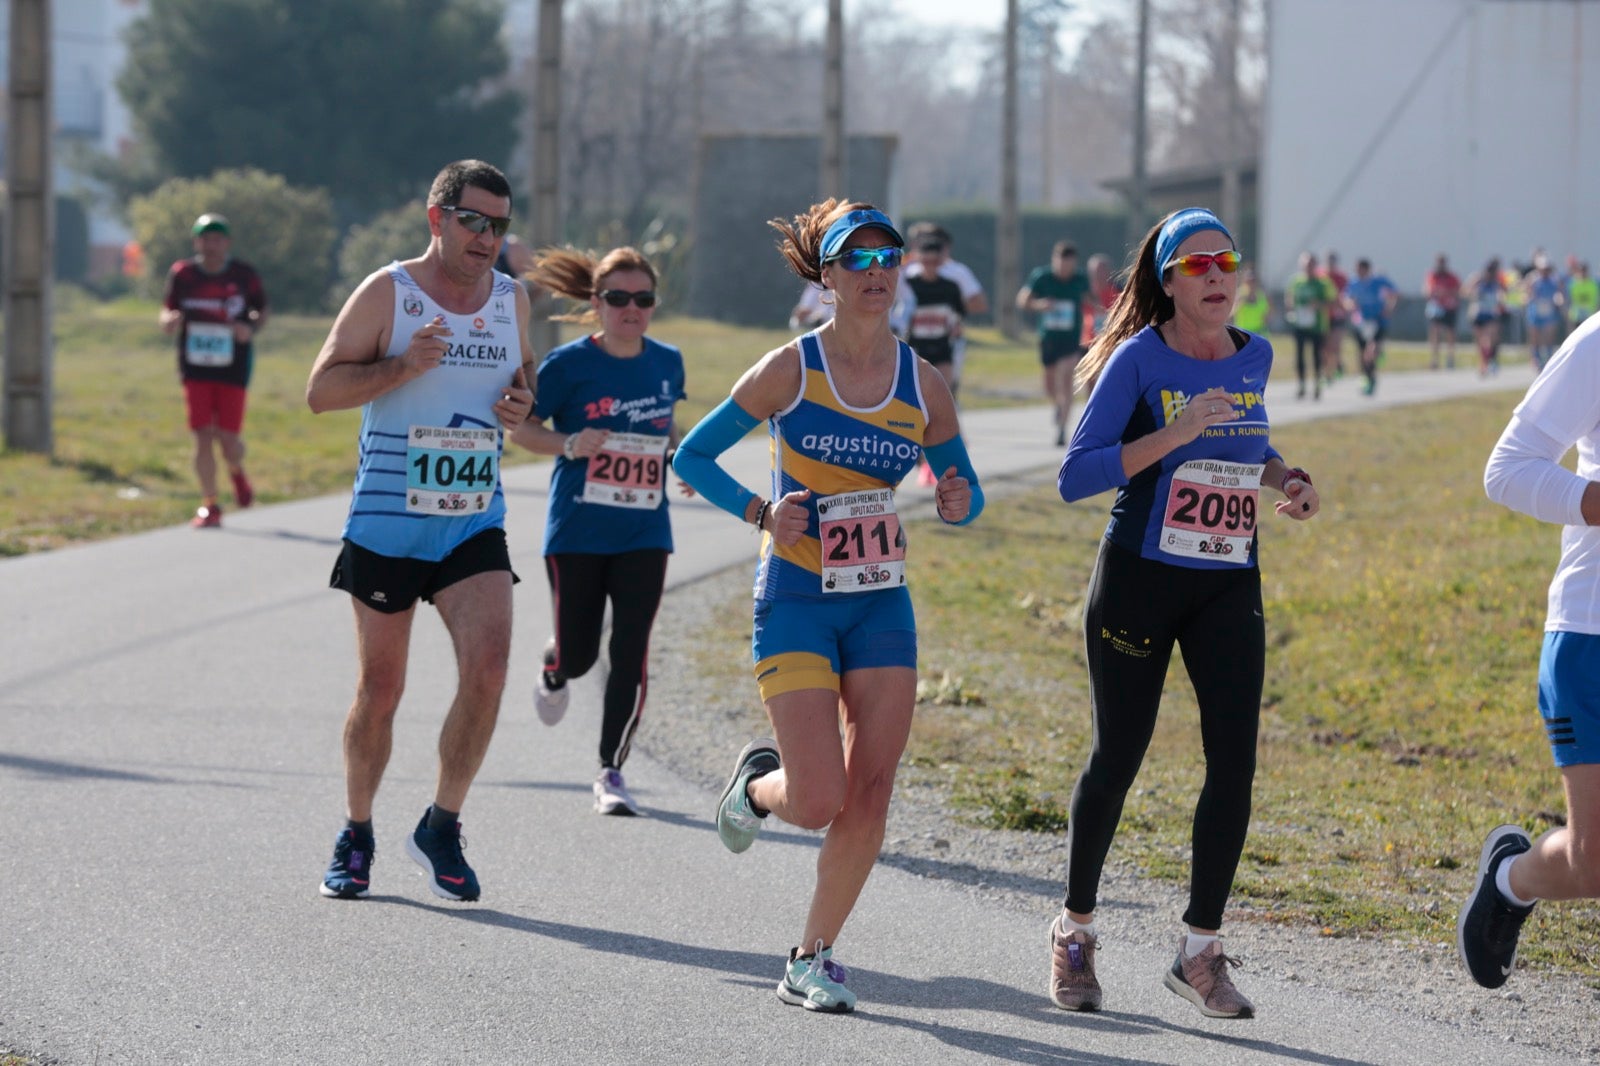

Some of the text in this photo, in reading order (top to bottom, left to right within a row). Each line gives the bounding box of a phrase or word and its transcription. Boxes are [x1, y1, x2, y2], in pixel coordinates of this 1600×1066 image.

[442, 343, 508, 361] RACENA
[1201, 428, 1226, 438] TRAIL
[1229, 428, 1236, 436] &
[801, 433, 919, 461] agustinos
[413, 453, 493, 487] 1044
[592, 453, 659, 485] 2019
[820, 455, 902, 471] GRANADA
[1204, 462, 1223, 473] GRAN
[844, 495, 857, 506] GRAN
[858, 492, 879, 504] PREMIO
[880, 491, 889, 502] DE
[1171, 487, 1255, 531] 2099
